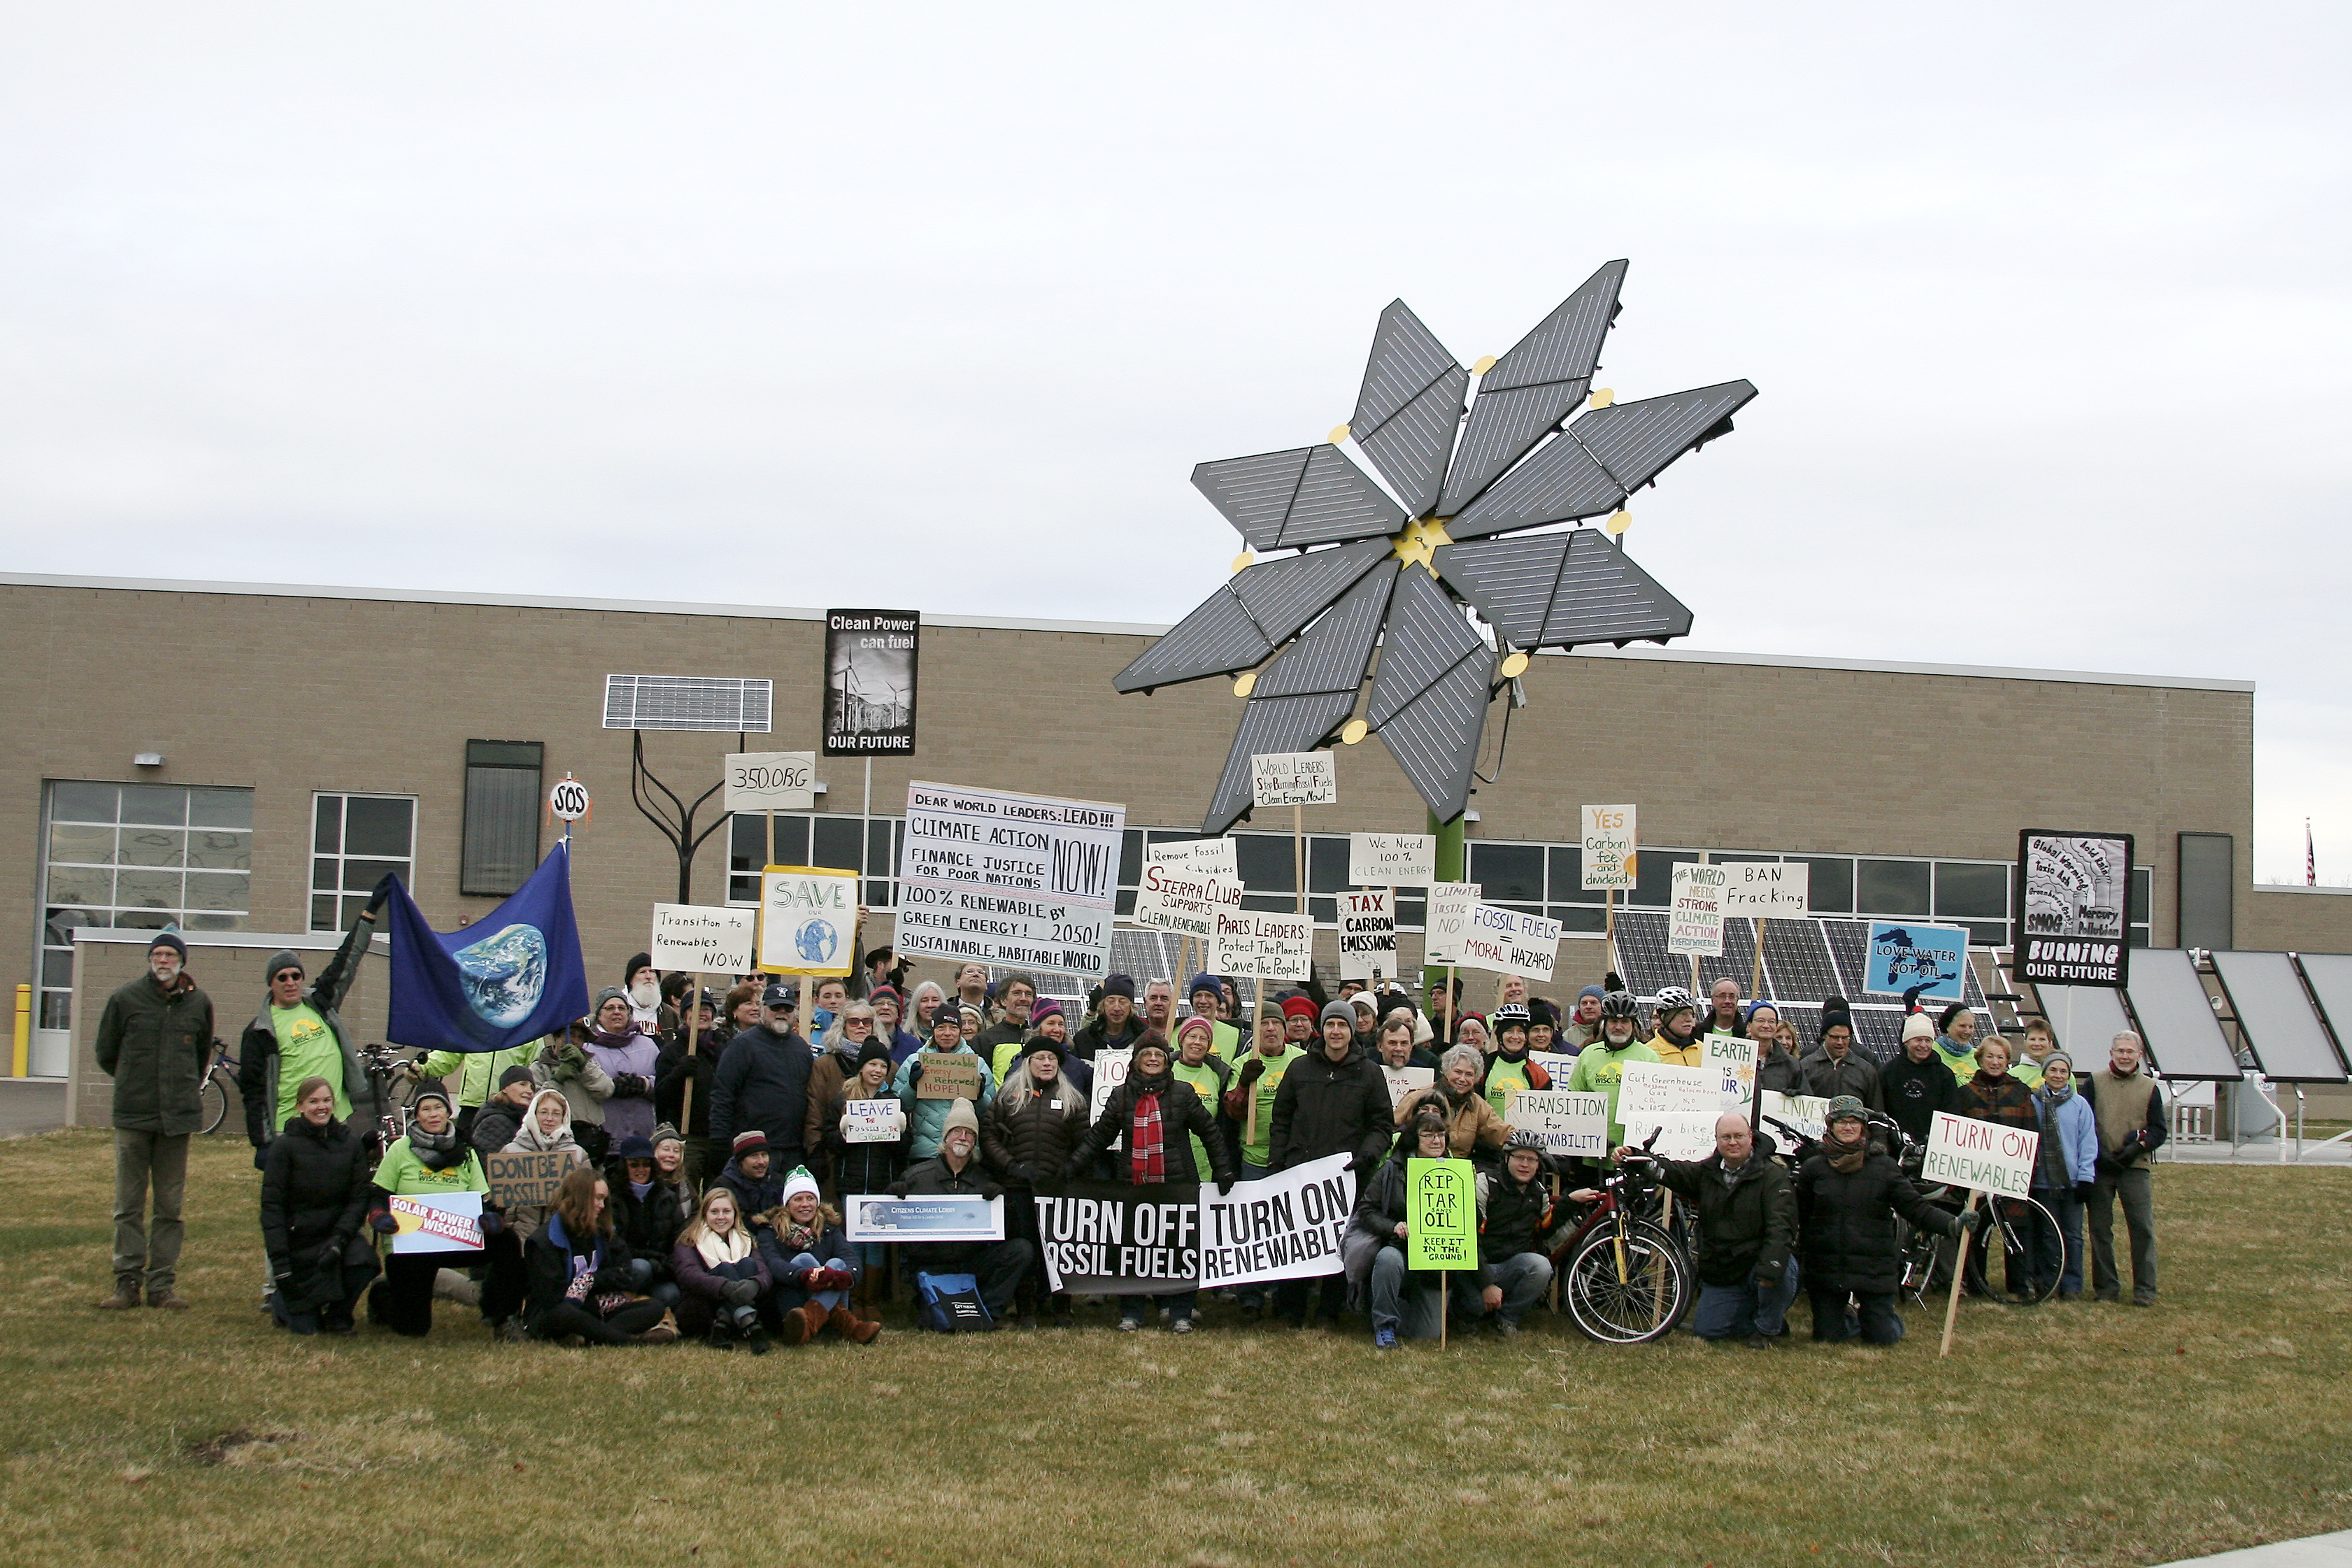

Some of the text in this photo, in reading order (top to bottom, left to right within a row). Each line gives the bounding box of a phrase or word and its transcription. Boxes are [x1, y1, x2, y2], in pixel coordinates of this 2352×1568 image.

[831, 616, 915, 630] Clean Power
[860, 635, 914, 649] can fuel
[828, 736, 910, 748] OUR FUTURE
[732, 767, 808, 789] 350.ORG
[555, 786, 585, 813] SOS
[915, 794, 947, 807] DEAR
[954, 800, 996, 813] WORLD
[1004, 805, 1062, 821] LEADERS:
[1592, 808, 1624, 829] YES
[1369, 836, 1423, 849] We Need
[1586, 836, 1625, 850] Carbon
[912, 818, 1110, 896] CLIMATE ACTION NOW!
[1154, 843, 1225, 862] Remove Fossil
[1596, 851, 1618, 863] fee
[2080, 841, 2109, 876] Acid Rain
[912, 848, 1045, 875] FINANCE JUSTICE
[1597, 863, 1616, 871] and
[2034, 839, 2088, 890] Global Warming
[916, 865, 1041, 889] FOR POOR NATIONS
[1355, 866, 1433, 876] CLEAN ENERGY
[1586, 871, 1627, 885] dividend
[1672, 868, 1725, 886] THE WORLD
[1746, 867, 1781, 882] BAN
[2036, 860, 2071, 887] Toxic Ash
[1146, 866, 1241, 905] SIERRA CLUB
[1434, 887, 1481, 897] CLIMATE
[1689, 885, 1716, 898] NEEDS
[774, 881, 846, 909] SAVE
[1348, 895, 1383, 912] TAX
[1727, 888, 1803, 909] Fracking
[906, 887, 953, 905] 100%
[1050, 906, 1066, 921] BY
[1161, 895, 1213, 915] SUPPORTS
[1677, 898, 1718, 912] STRONG
[660, 912, 741, 927] Transition to
[1474, 907, 1558, 940] FOSSIL FUELS
[1676, 911, 1719, 926] CLIMATE
[2028, 913, 2062, 932] SMOG
[2079, 905, 2118, 925] Mercury
[904, 912, 951, 926] GREEN
[1051, 922, 1100, 945] 2050!
[1217, 913, 1309, 939] PARIS LEADERS:
[1346, 917, 1394, 932] CARBON
[1675, 925, 1718, 938] ACTION
[2079, 921, 2119, 936] Pollution
[657, 934, 718, 947] Renewables
[1218, 937, 1255, 952] Protect
[1257, 940, 1274, 954] The
[1341, 935, 1396, 952] EMISSIONS
[703, 953, 743, 967] NOW
[902, 933, 1101, 971] SUSTAINABLE, HABITABLE WORLD
[1464, 939, 1553, 971] MORAL HAZARD
[1876, 946, 1956, 962] LOVE WATER
[1221, 953, 1306, 978] Save The People!
[1890, 962, 1941, 978] NOT OIL
[2026, 963, 2117, 981] OUR FUTURE
[1711, 1040, 1751, 1062] EARTH
[922, 1055, 976, 1068] Renewable
[924, 1066, 951, 1079] Energy
[934, 1076, 975, 1085] Renewed
[1628, 1073, 1702, 1087] Cut Greenhouse
[925, 1083, 960, 1095] HOPE!
[1649, 1088, 1667, 1097] Gas
[850, 1102, 893, 1117] LEAVE
[1516, 1095, 1607, 1116] TRANSITION
[1544, 1118, 1562, 1129] for
[1539, 1133, 1601, 1149] INABILITY
[1940, 1117, 2034, 1161] TURN ON
[537, 1154, 558, 1178] BE
[561, 1154, 575, 1178] A
[1927, 1151, 2030, 1194] RENEWABLES
[1424, 1175, 1453, 1189] RIP
[1424, 1193, 1457, 1209] TAR
[392, 1199, 473, 1230] SOLAR POWER
[1210, 1176, 1348, 1246] TURN ON
[1034, 1196, 1197, 1248] TURN OFF
[1425, 1213, 1457, 1228] OIL
[424, 1218, 482, 1244] WISCONSIN
[1424, 1237, 1446, 1246] KEEP
[1050, 1242, 1197, 1280] OSSIL FUELS
[1429, 1250, 1467, 1261] GROUND!
